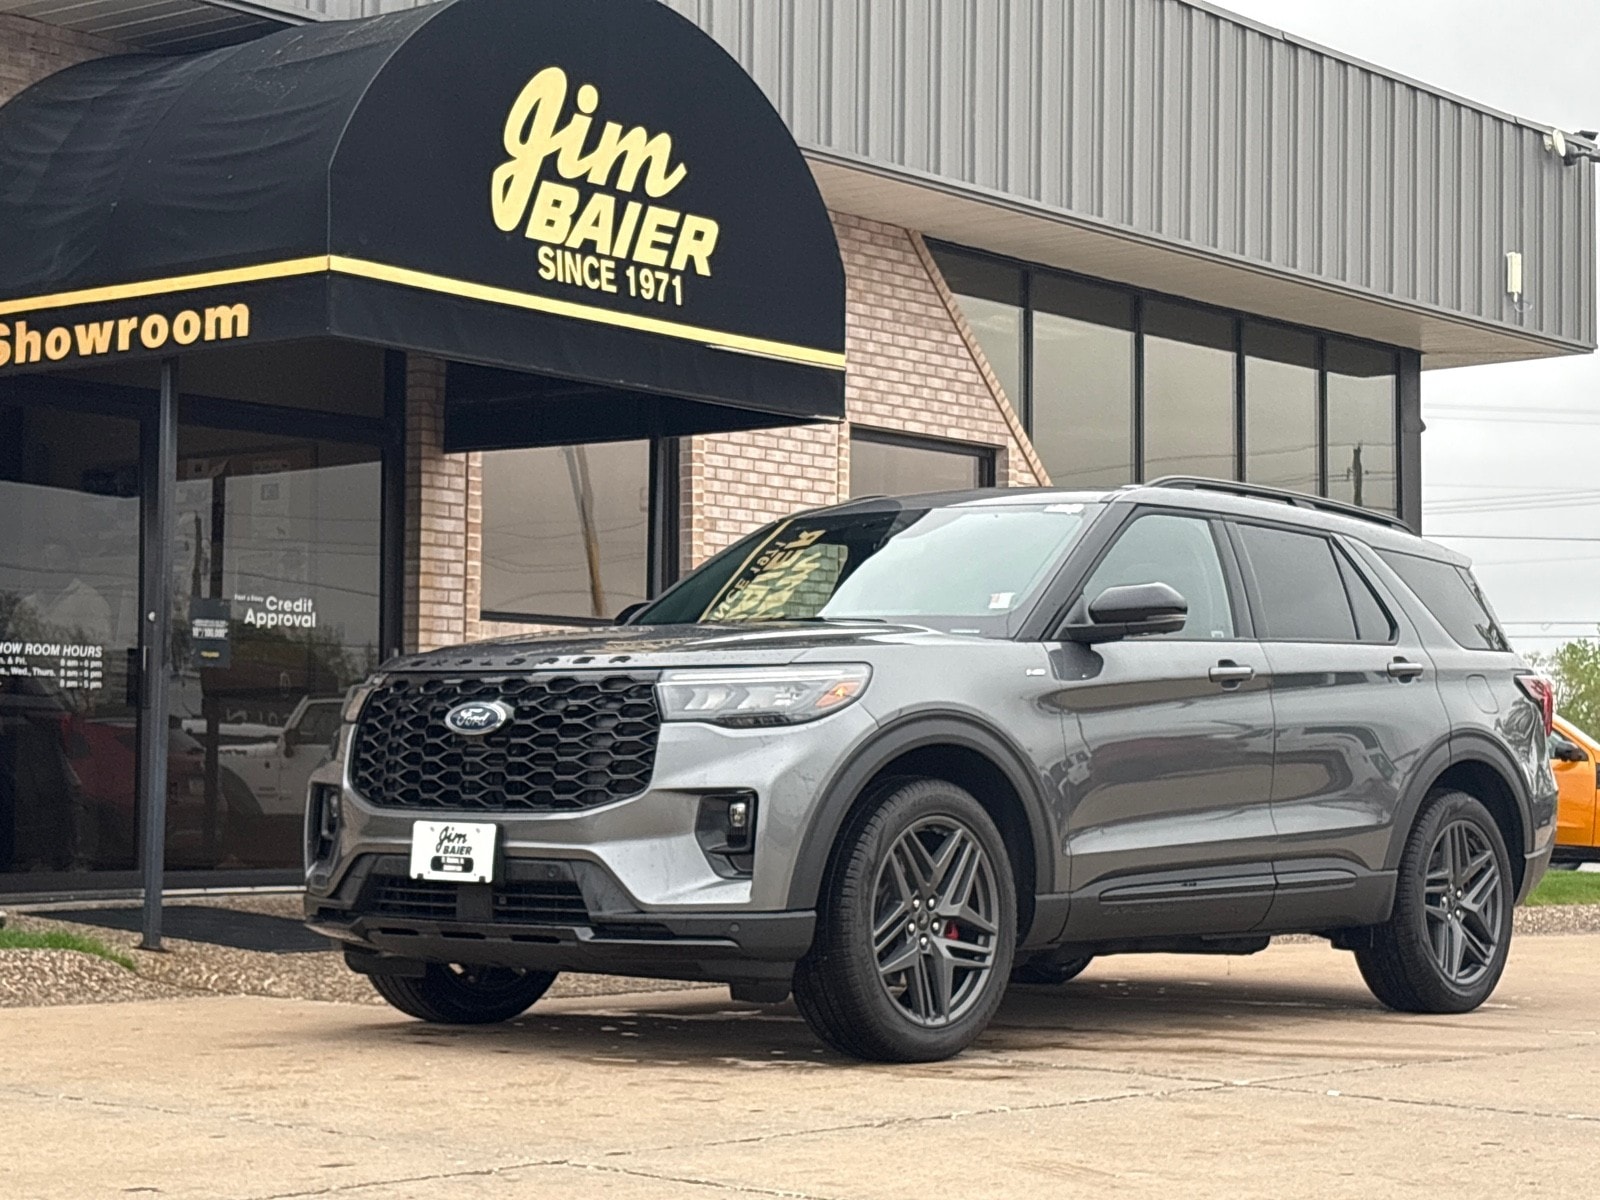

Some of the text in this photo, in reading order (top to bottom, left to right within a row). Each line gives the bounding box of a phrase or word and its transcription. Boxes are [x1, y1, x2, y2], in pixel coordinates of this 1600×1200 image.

[492, 66, 687, 232] Jim
[525, 180, 719, 277] BAIER
[537, 245, 683, 306] SINCE 1971
[266, 595, 313, 613] Credit
[244, 607, 316, 628] Approval
[25, 643, 60, 656] ROOM
[62, 645, 103, 658] HOURS
[90, 660, 103, 669] pm
[90, 670, 103, 680] pm
[90, 681, 103, 690] pm
[456, 708, 491, 727] Ford
[436, 826, 467, 853] Jim
[443, 845, 472, 855] BAIER
